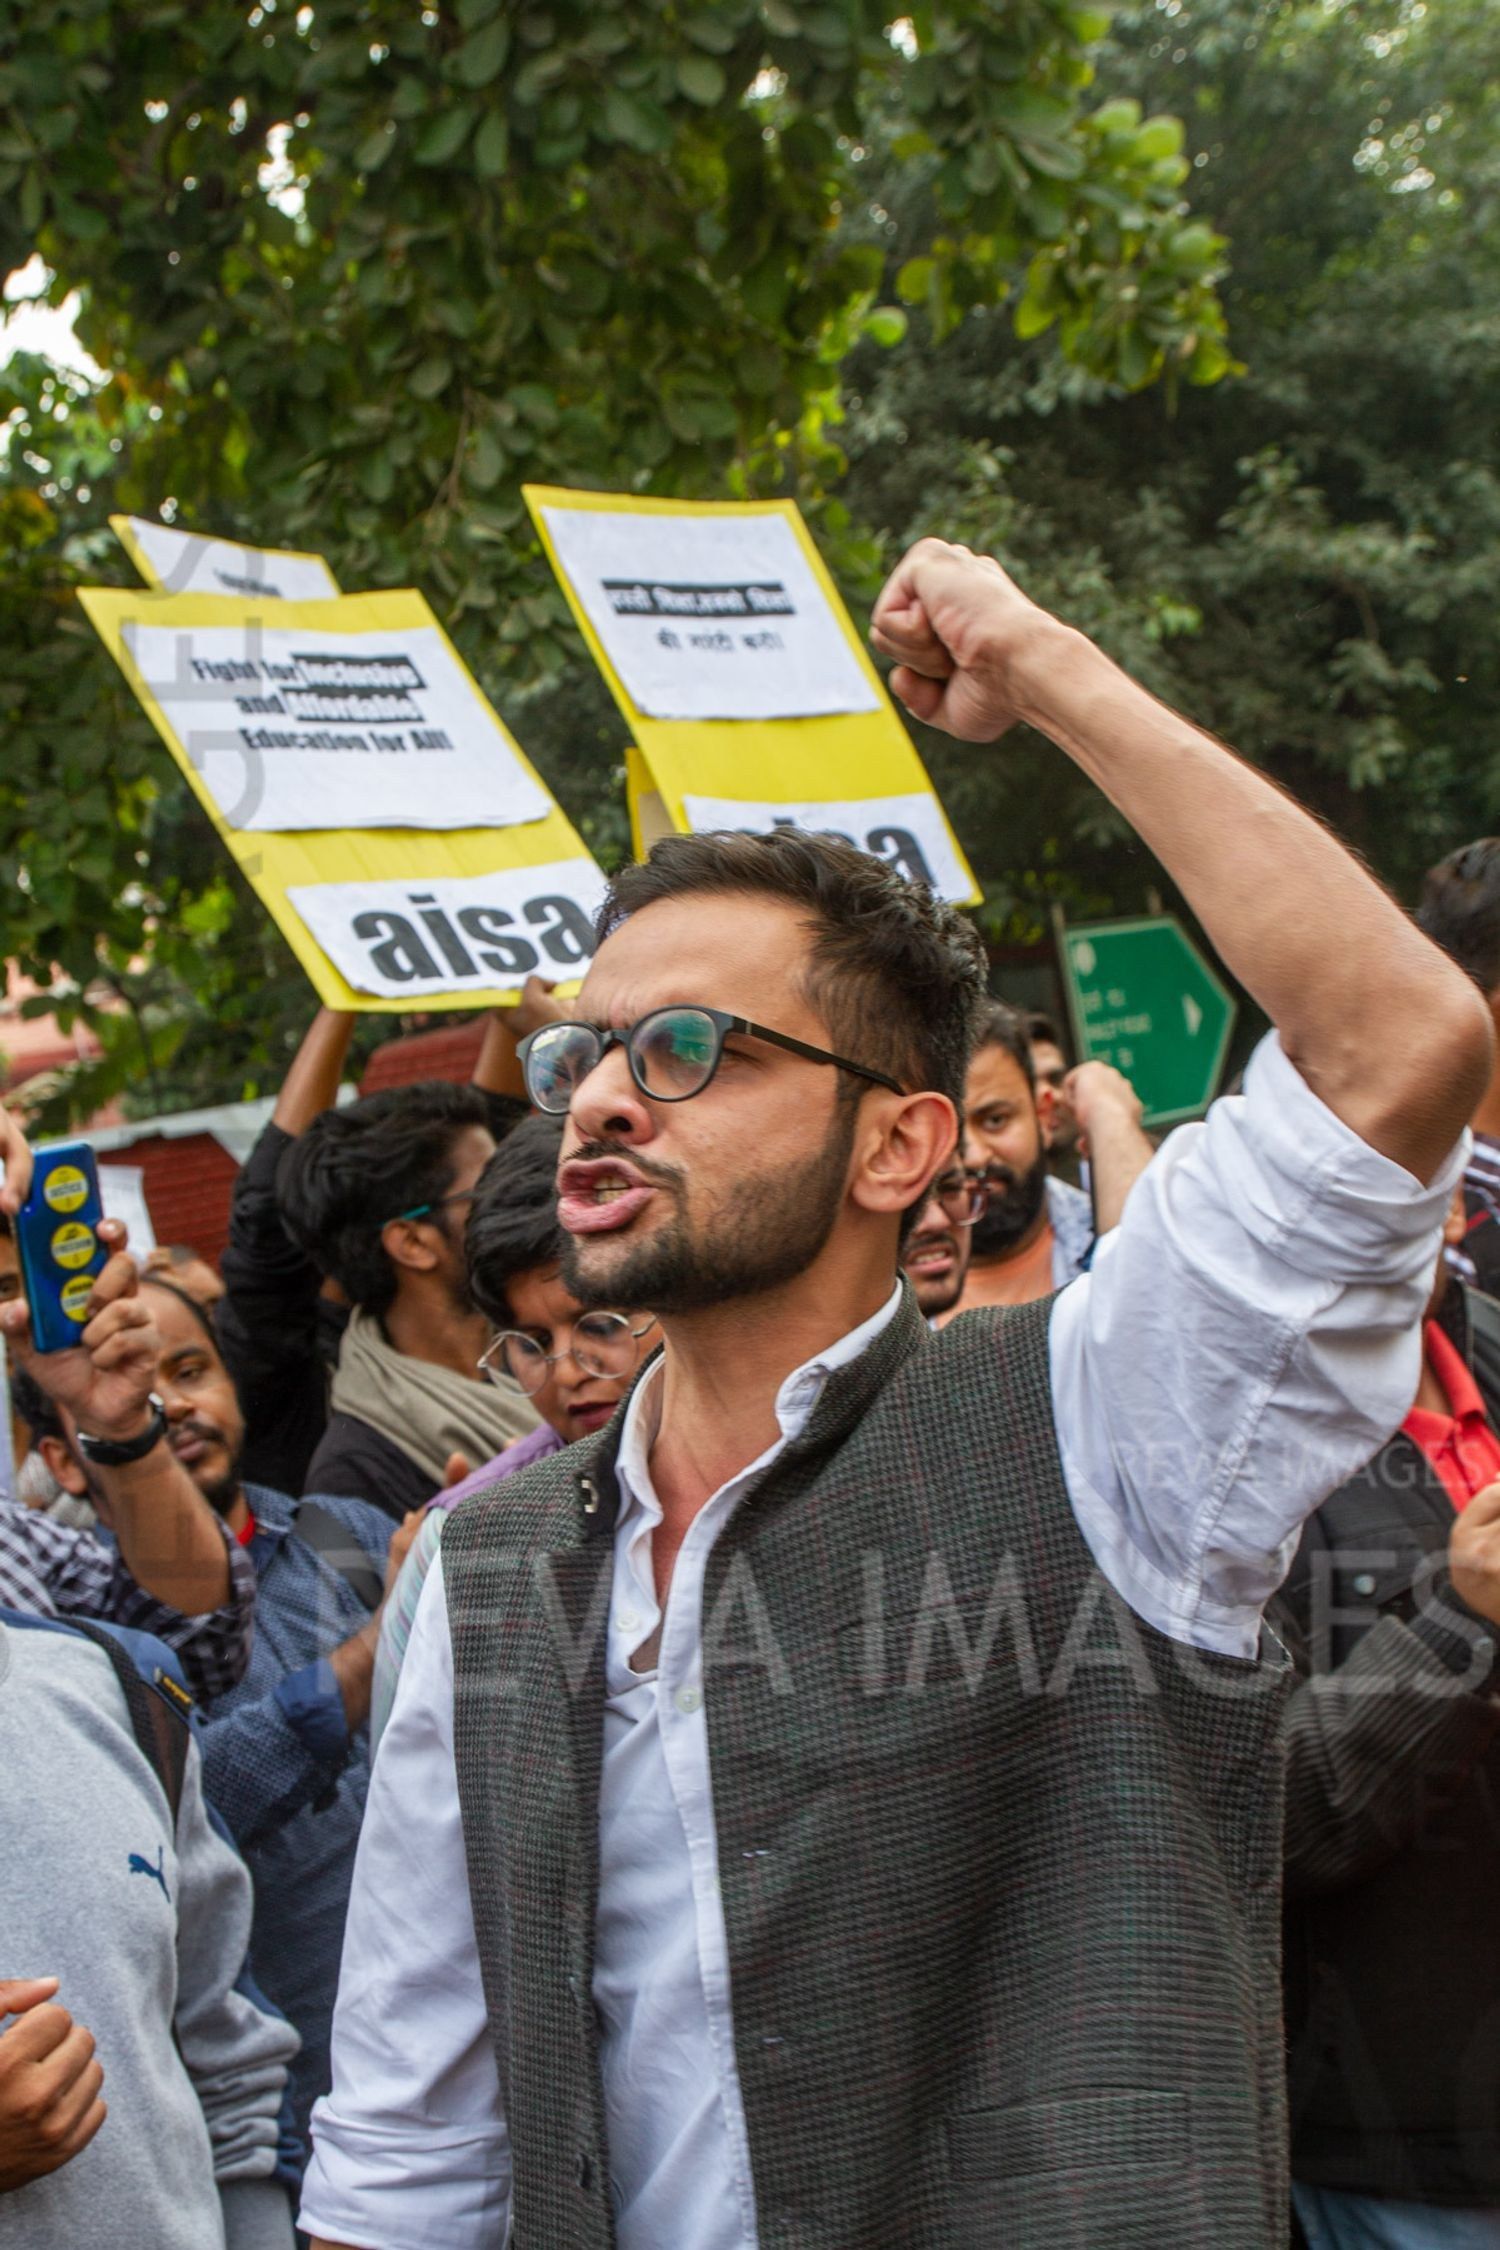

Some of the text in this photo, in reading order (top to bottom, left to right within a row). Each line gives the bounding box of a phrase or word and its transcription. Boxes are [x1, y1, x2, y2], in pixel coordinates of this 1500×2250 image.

[191, 660, 420, 688] Fight for Inclusive
[235, 691, 420, 721] and Affordable
[238, 727, 371, 751] Education
[367, 730, 405, 751] for
[352, 893, 599, 982] aisa
